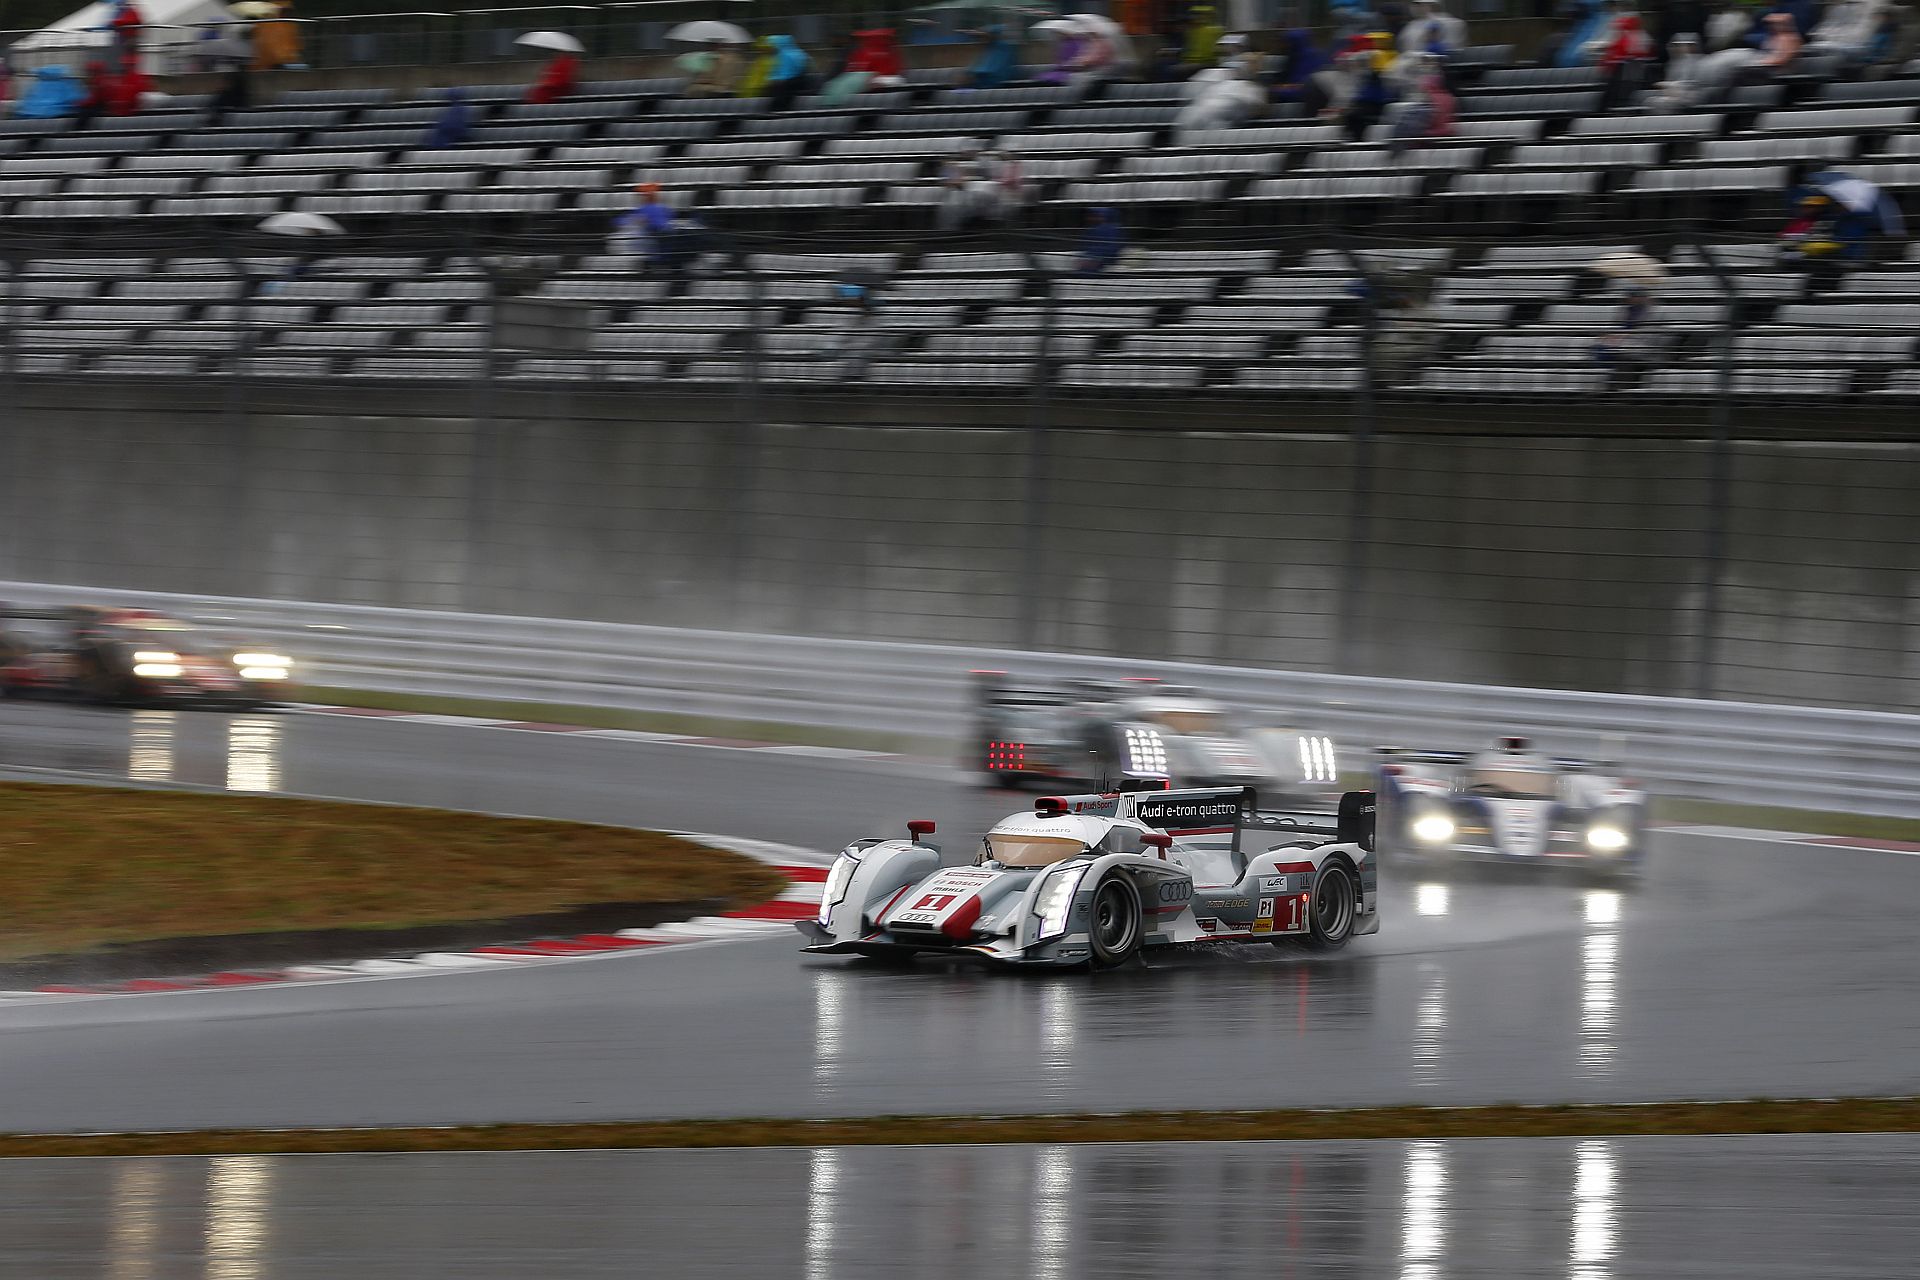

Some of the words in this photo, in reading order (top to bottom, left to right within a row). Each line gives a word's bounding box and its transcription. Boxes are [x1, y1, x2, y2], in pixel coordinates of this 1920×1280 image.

[1083, 801, 1096, 809] Audi
[1096, 800, 1113, 809] Sport
[1140, 804, 1164, 818] Audi
[1166, 804, 1197, 816] e-tron
[1199, 803, 1237, 818] quattro
[1266, 877, 1285, 887] WEC
[917, 895, 942, 910] 1
[1224, 899, 1250, 908] EDGE
[1260, 900, 1272, 915] P1
[1287, 898, 1300, 930] 1
